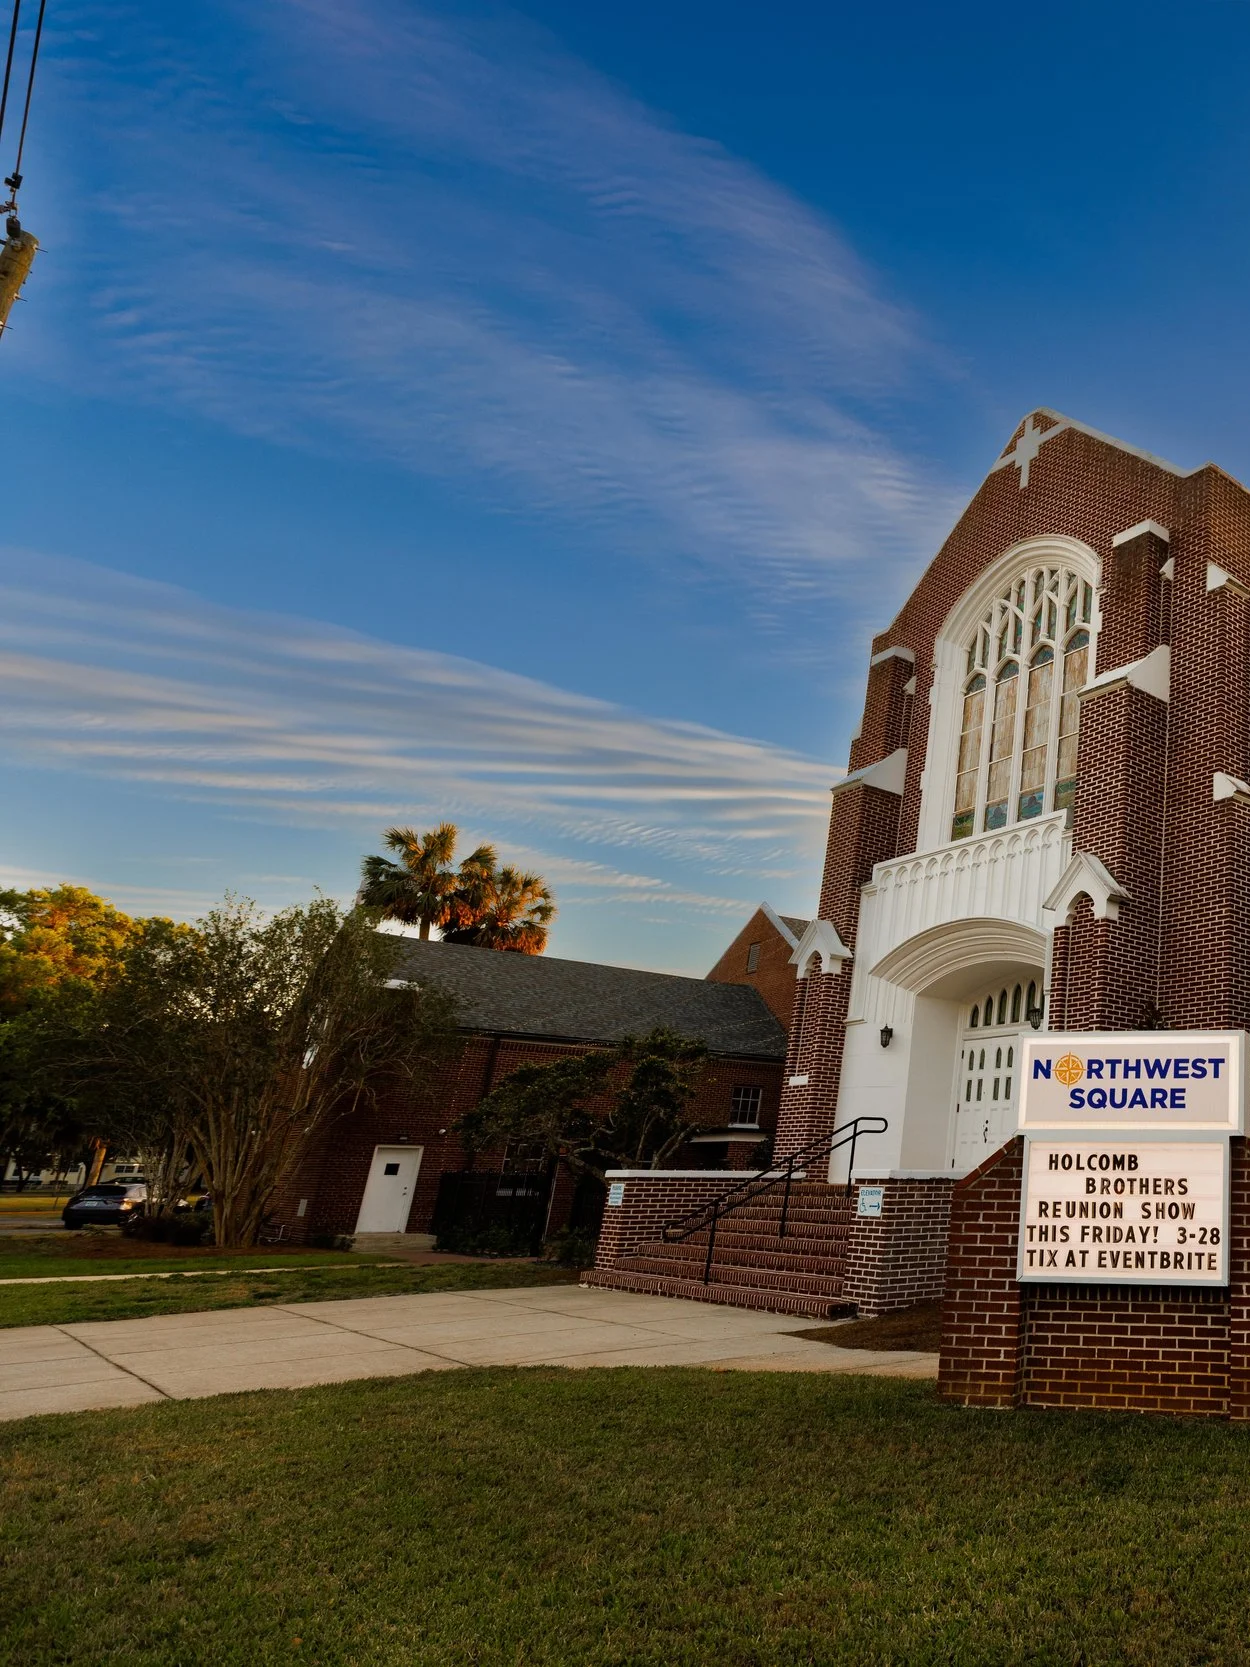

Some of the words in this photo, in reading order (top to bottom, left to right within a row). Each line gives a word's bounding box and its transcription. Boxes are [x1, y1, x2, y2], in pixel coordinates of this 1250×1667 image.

[1069, 1088, 1187, 1110] SQUARE
[1048, 1154, 1139, 1171] HOLCOMB
[1085, 1178, 1188, 1195] BROTHERS
[1038, 1201, 1123, 1219] REUNION
[1141, 1202, 1196, 1220] SHOW
[1026, 1225, 1070, 1243] THIS
[1080, 1226, 1159, 1244] FRIDAY!
[1176, 1227, 1221, 1246] 3-28
[1026, 1249, 1058, 1268] TIX
[1065, 1250, 1090, 1268] AT
[1097, 1251, 1217, 1270] EVENTBRITE
